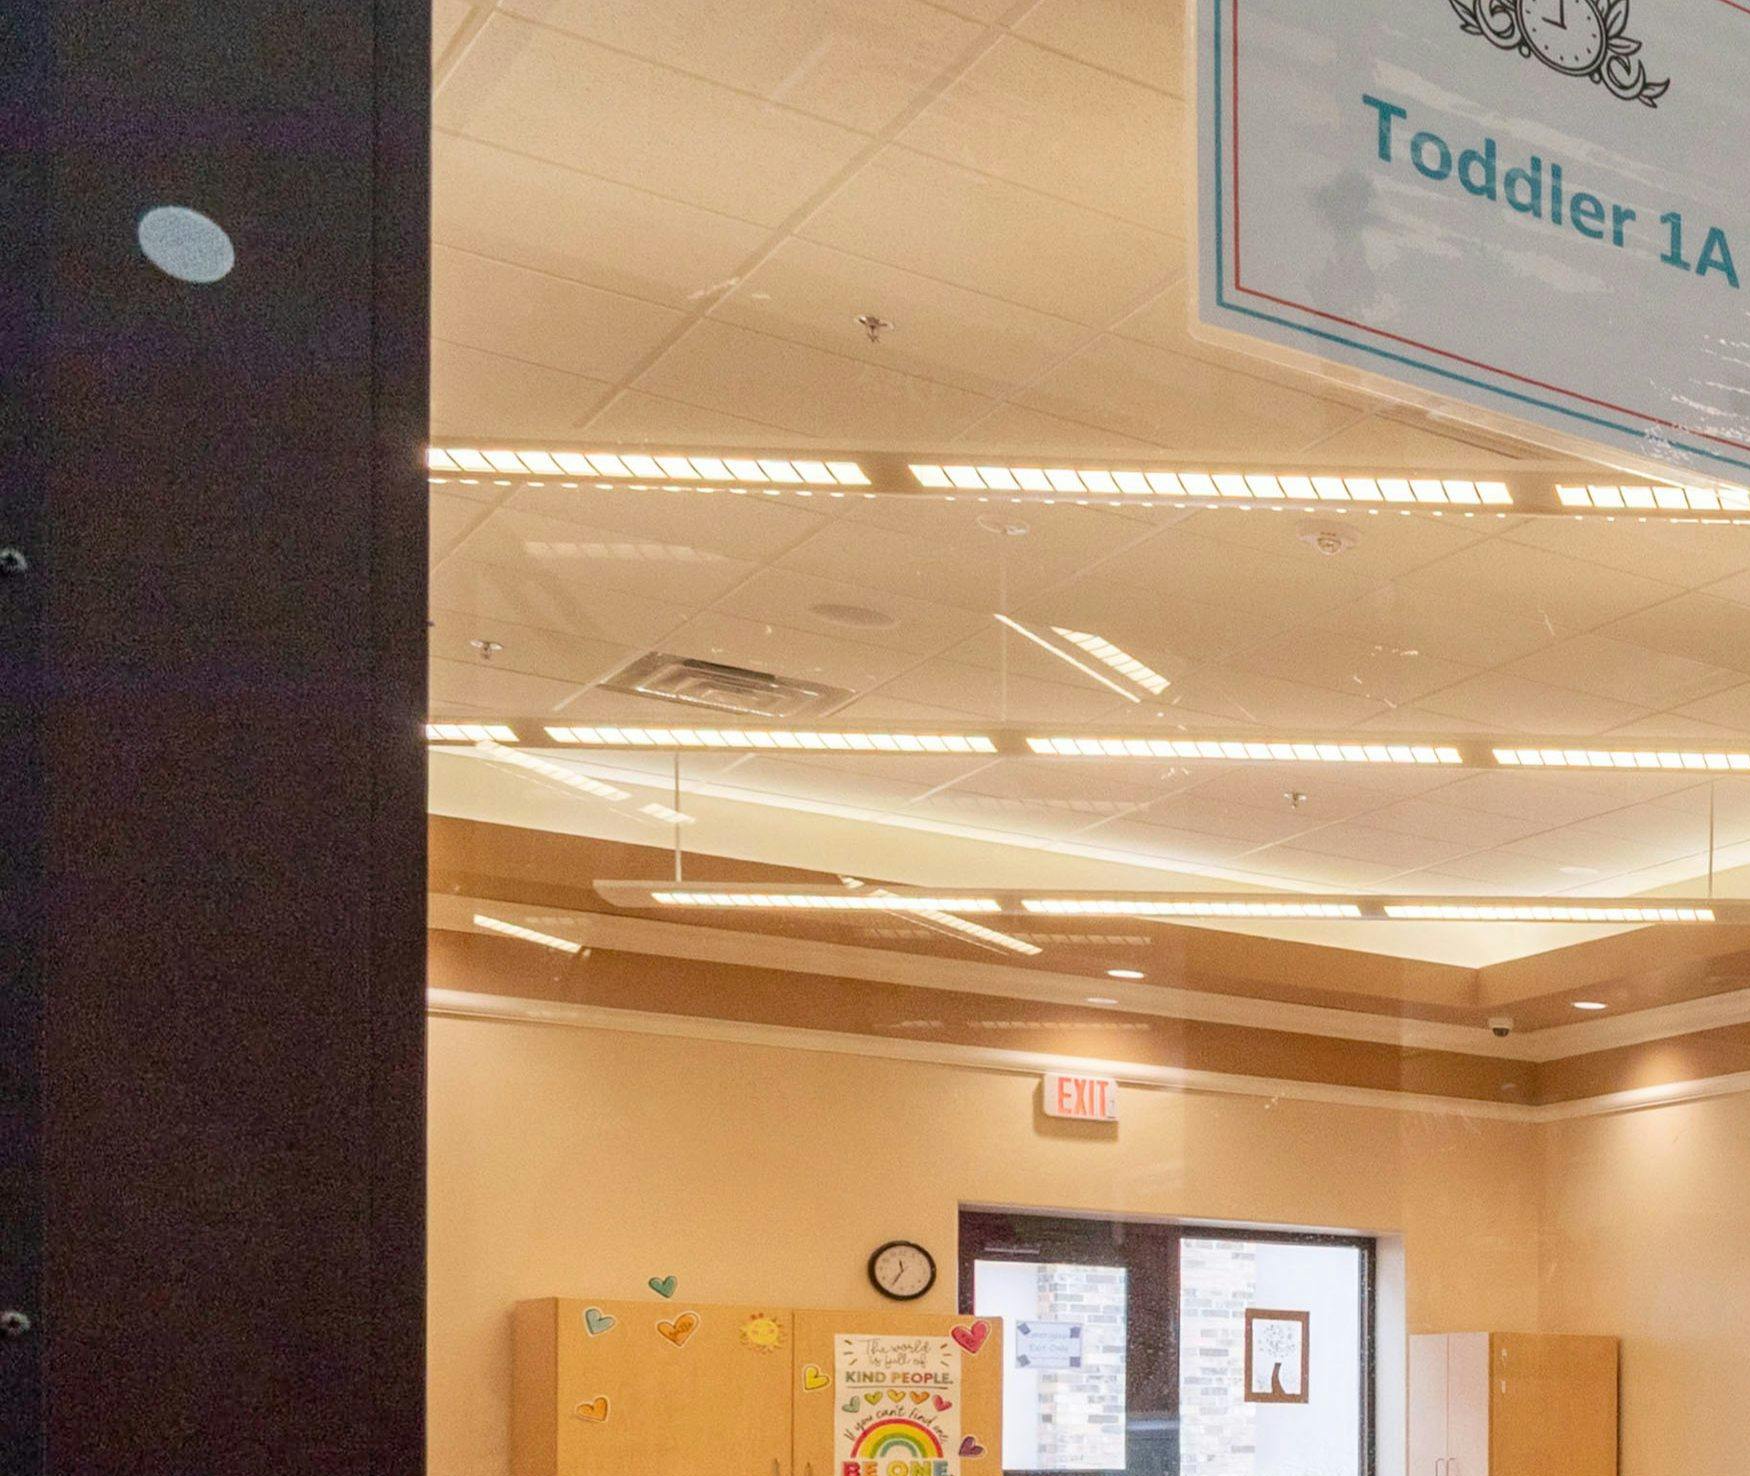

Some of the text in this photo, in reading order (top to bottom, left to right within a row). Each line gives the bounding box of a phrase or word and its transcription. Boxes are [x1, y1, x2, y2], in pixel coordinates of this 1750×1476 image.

[1361, 92, 1740, 290] Toddler 1A
[1058, 1077, 1109, 1119] EXIT
[864, 1339, 931, 1355] The world
[884, 1353, 908, 1368] full
[845, 1371, 954, 1384] KIND PEOPLE.
[875, 1404, 905, 1418] can't
